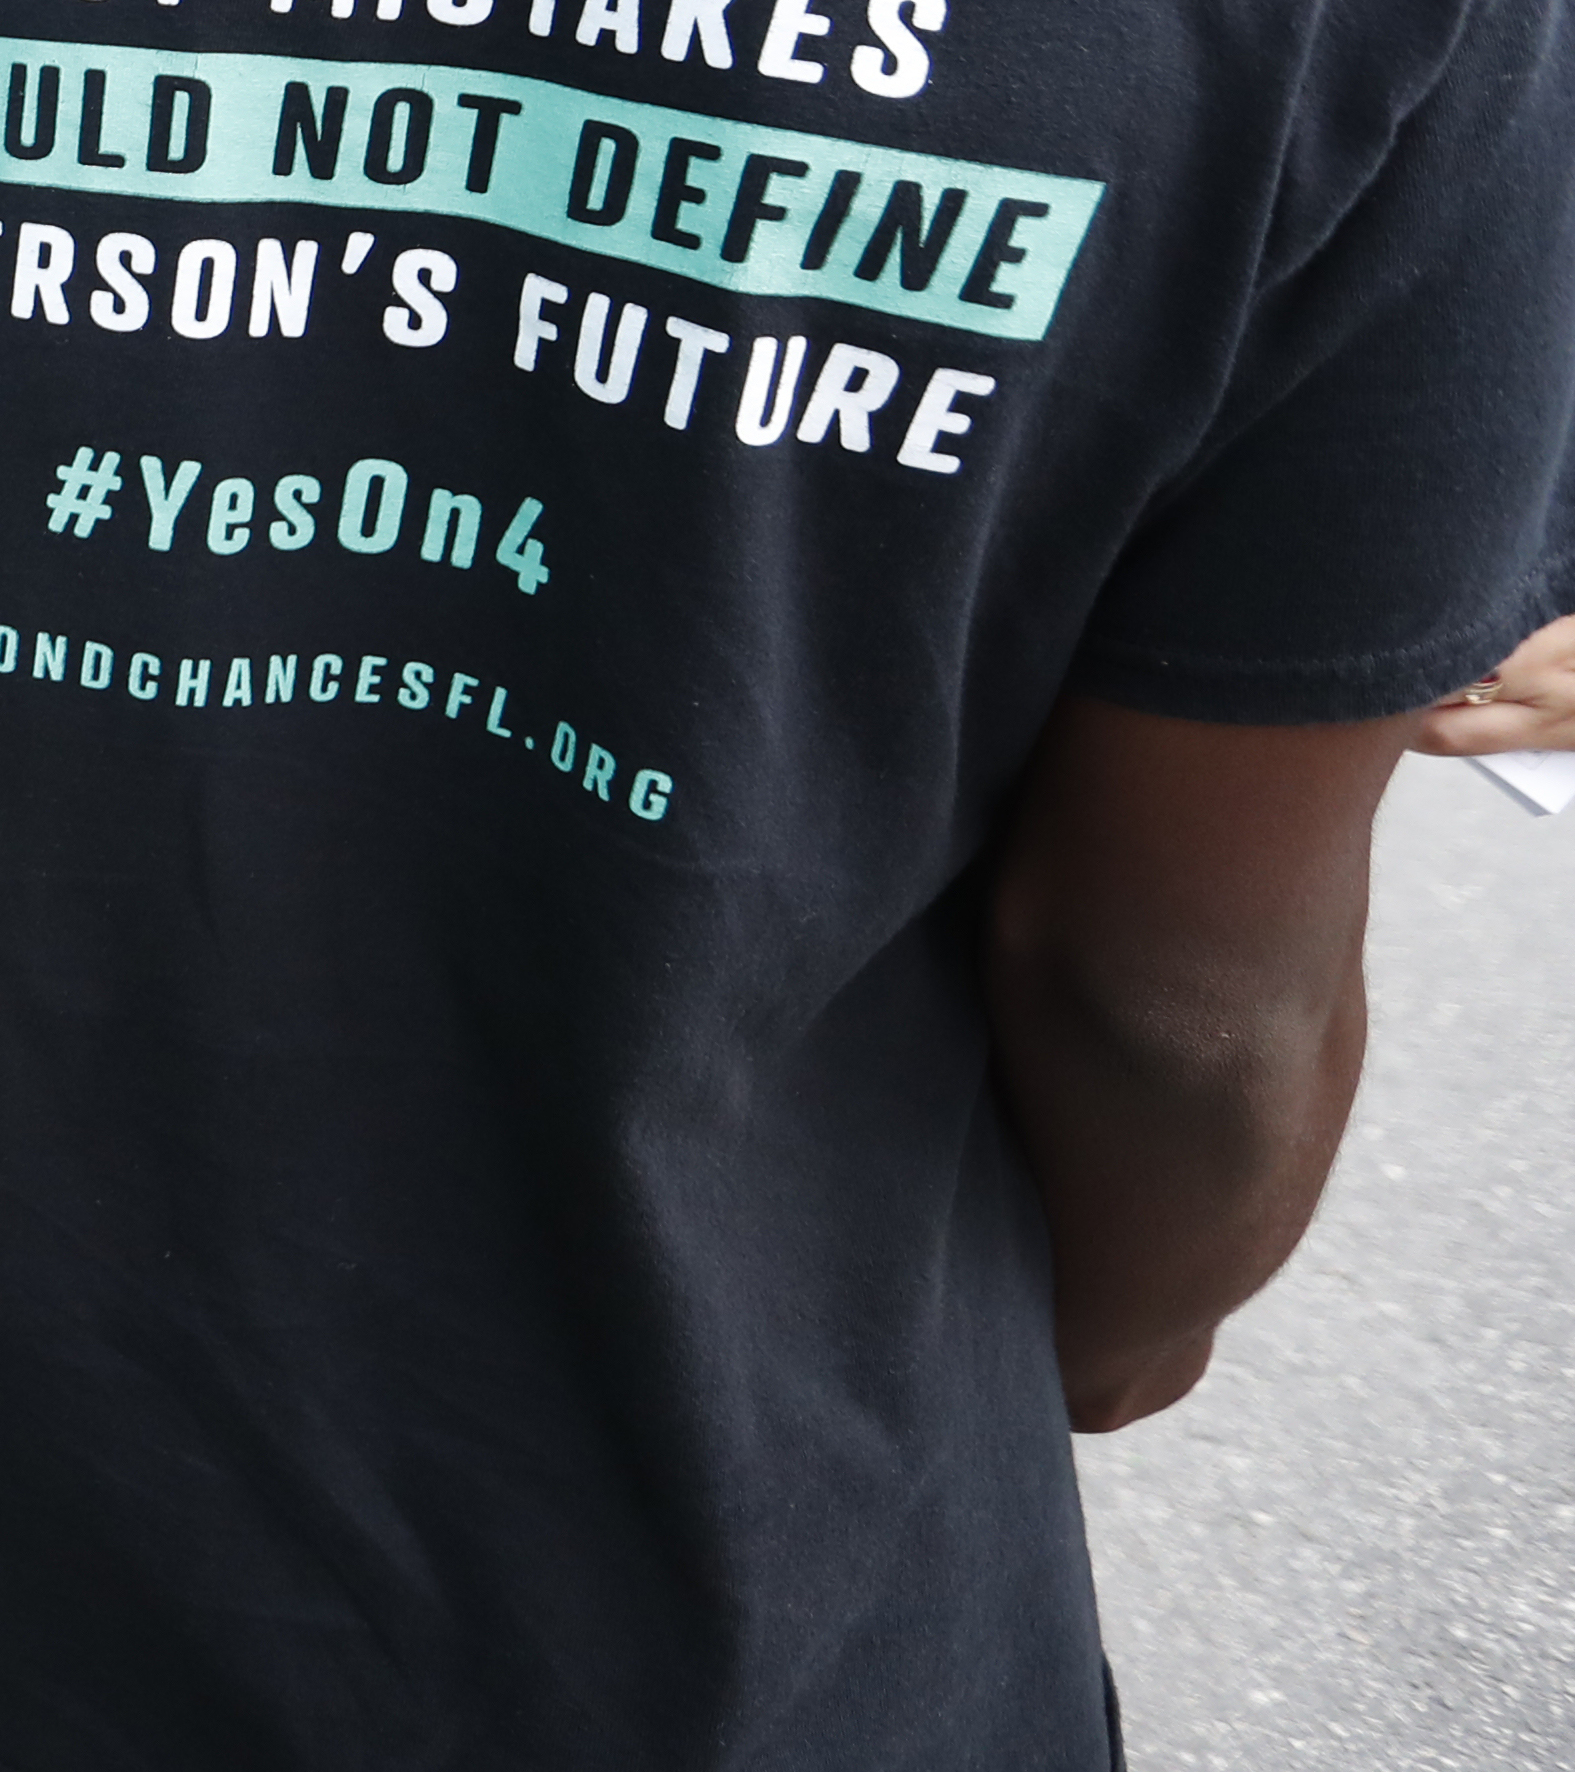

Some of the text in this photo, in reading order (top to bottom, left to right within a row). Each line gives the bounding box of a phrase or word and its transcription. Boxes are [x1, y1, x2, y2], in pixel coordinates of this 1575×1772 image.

[272, 81, 523, 194] NOT
[566, 119, 1049, 311] DEFINE
[513, 272, 997, 475] FUTURE
[46, 446, 550, 595] #YesOn4
